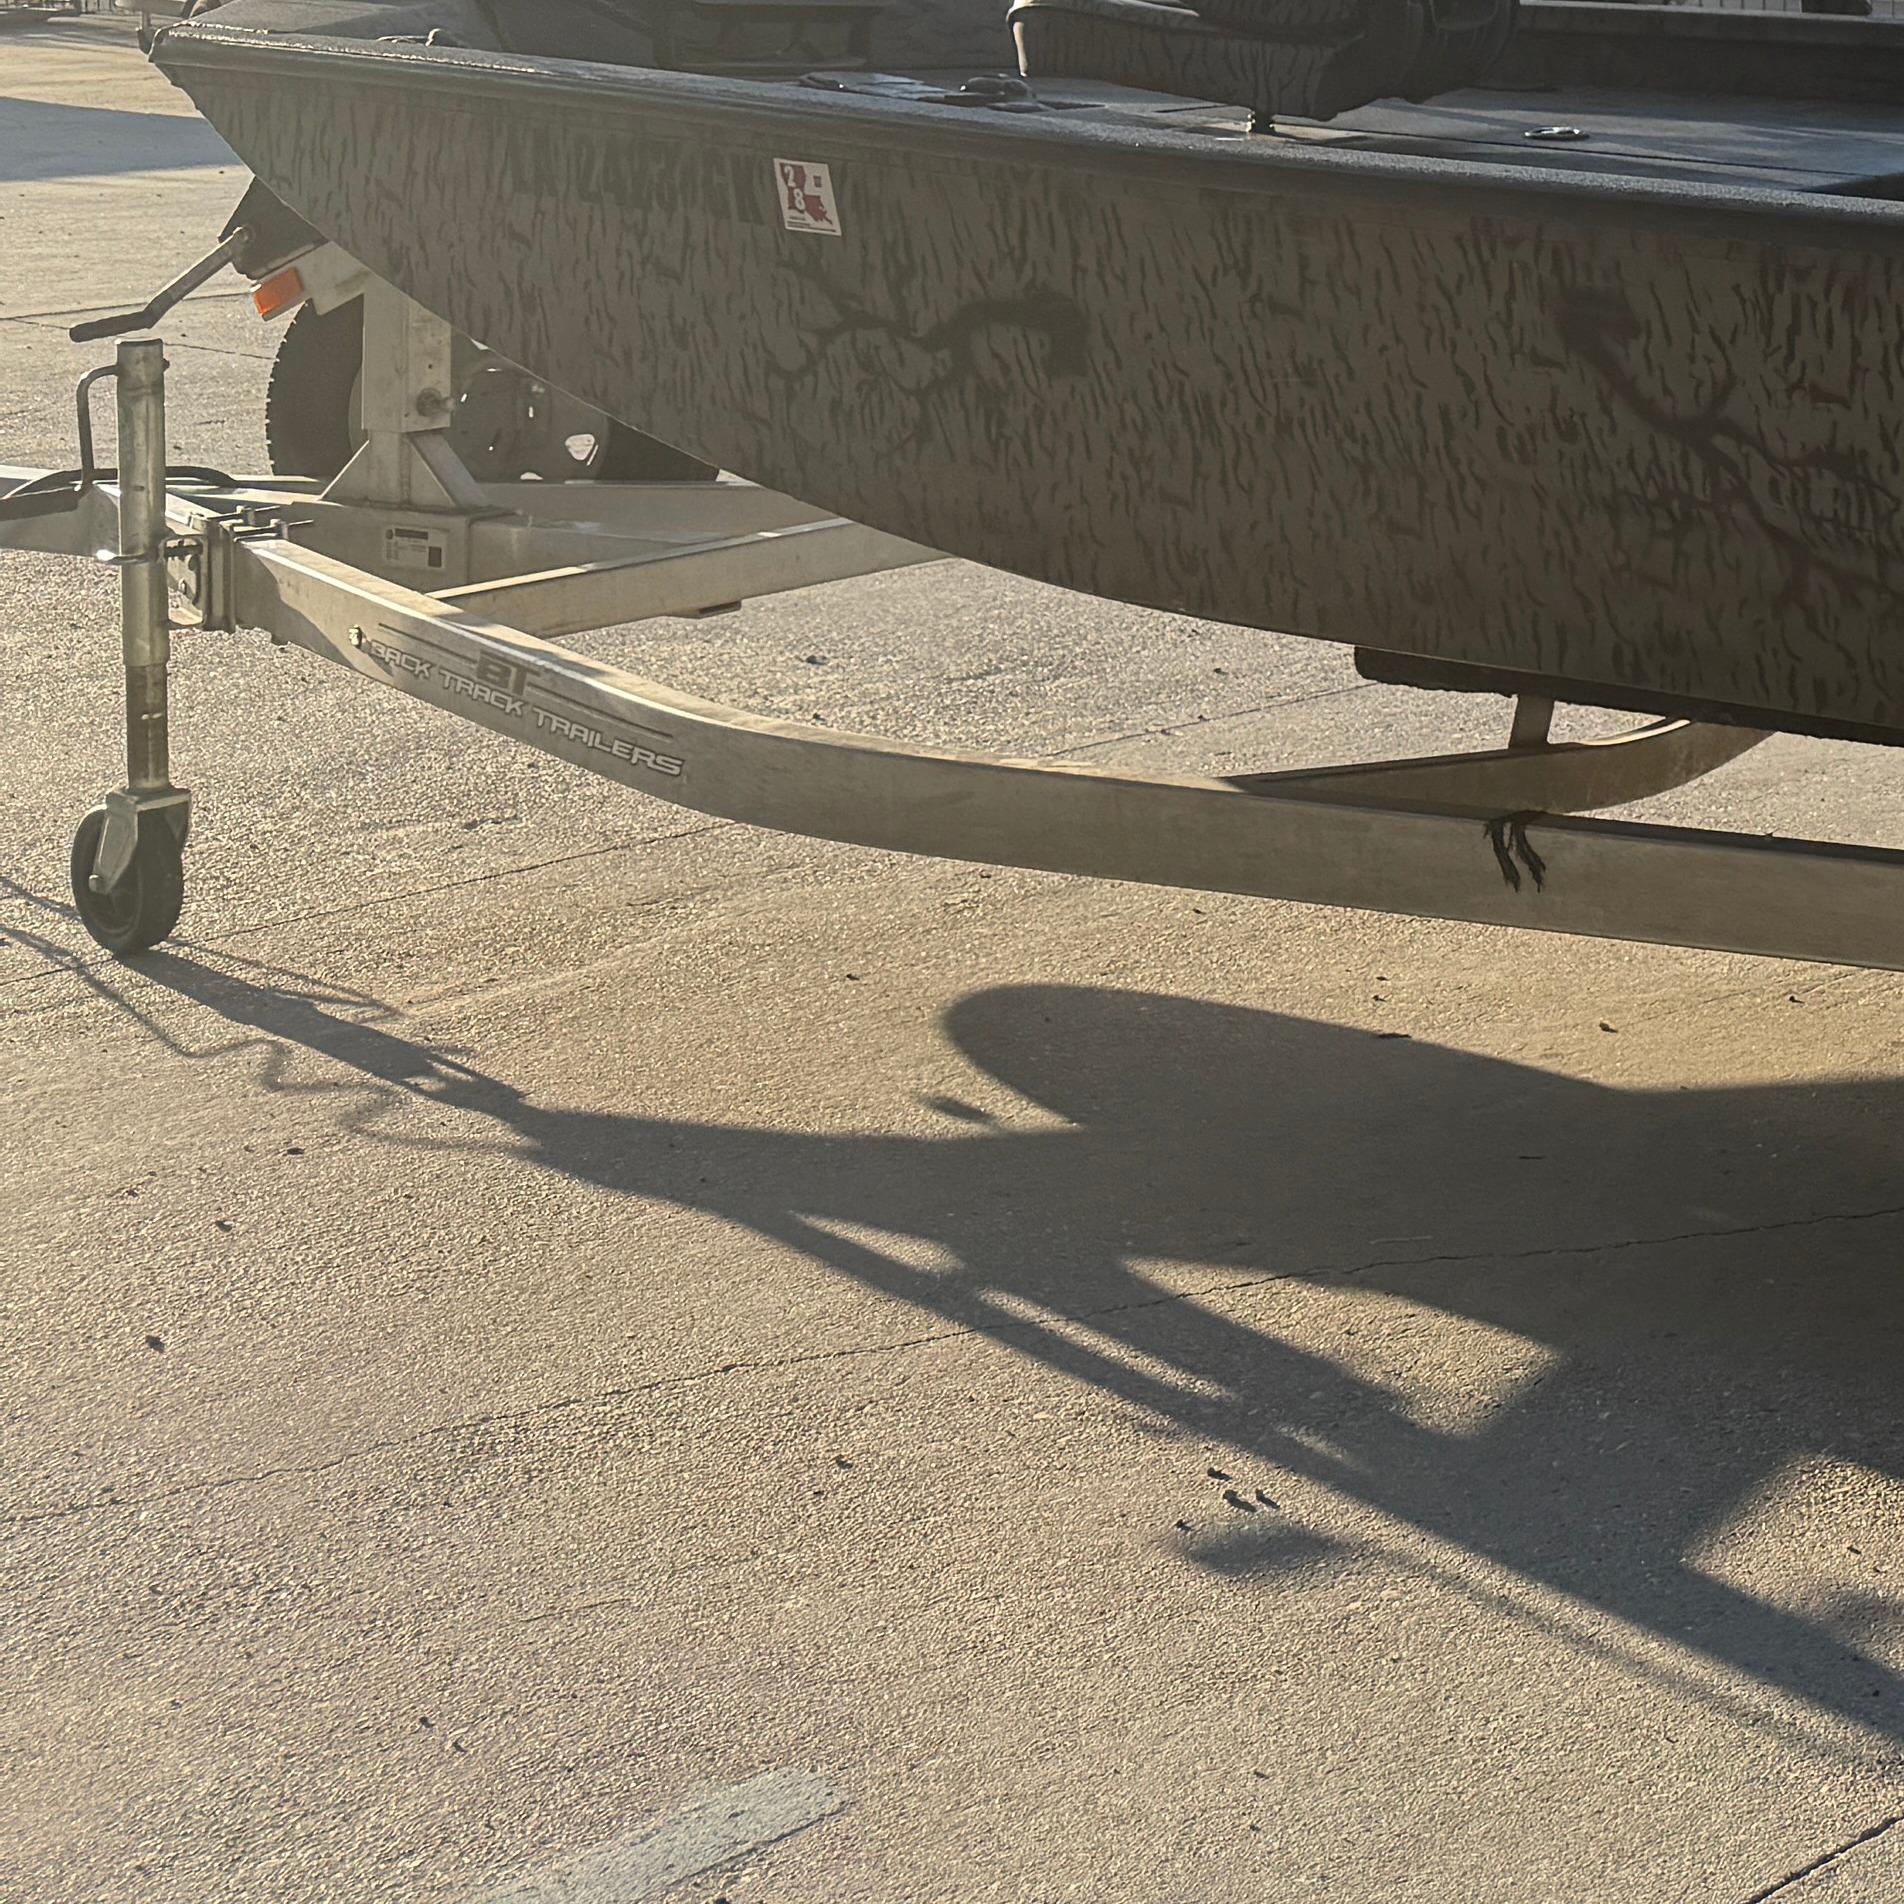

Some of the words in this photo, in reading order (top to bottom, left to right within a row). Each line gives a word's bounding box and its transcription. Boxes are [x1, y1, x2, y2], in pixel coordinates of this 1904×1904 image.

[370, 639, 434, 679] BACK
[438, 667, 525, 717] TRACK
[532, 707, 684, 776] TRAILERS
